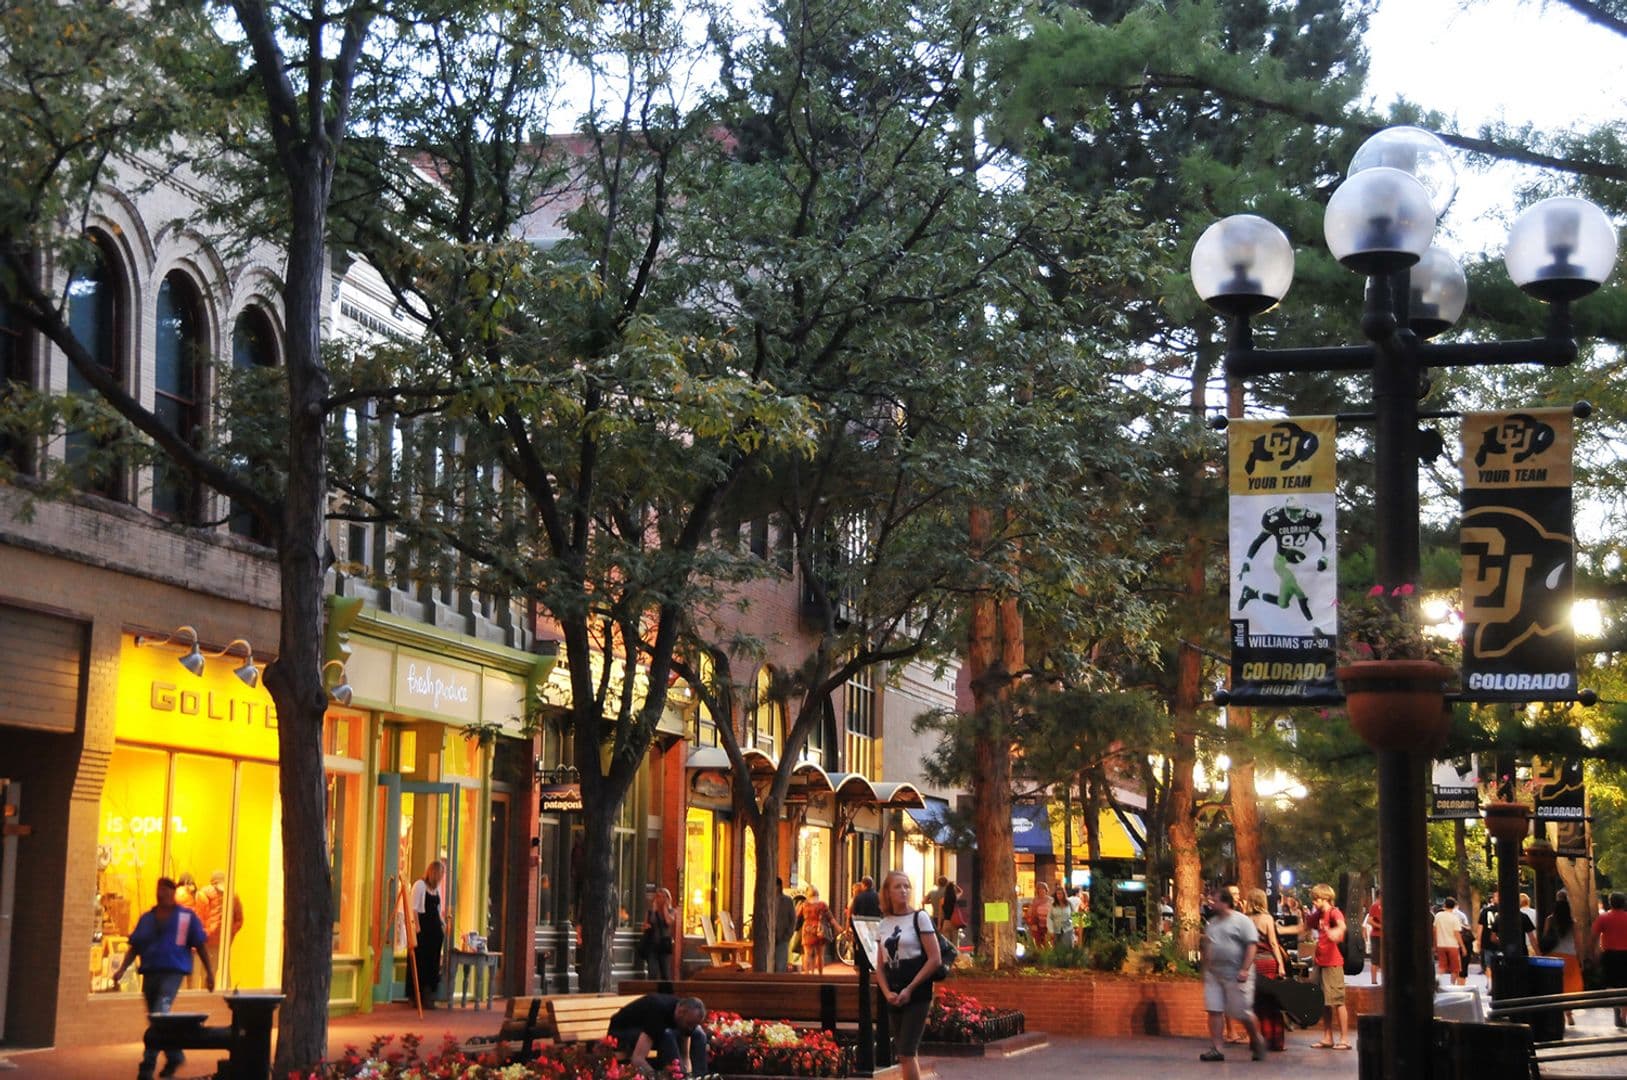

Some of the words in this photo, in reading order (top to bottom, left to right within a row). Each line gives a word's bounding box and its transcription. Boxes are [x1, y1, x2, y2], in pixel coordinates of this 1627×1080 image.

[1478, 470, 1510, 483] YOUR
[1515, 468, 1548, 482] TEAM
[1248, 477, 1277, 490] YOUR
[1282, 475, 1313, 489] TEAM
[1278, 526, 1311, 535] COLORADO
[1281, 534, 1307, 547] 94
[1248, 636, 1300, 649] WILLIAMS
[1242, 662, 1327, 681] COLORADO
[407, 662, 434, 695] fresh
[433, 671, 468, 710] produce
[1469, 672, 1571, 691] COLORADO
[543, 800, 583, 811] patagoni
[1437, 800, 1476, 809] COLORADO
[1537, 806, 1583, 817] COLORADO
